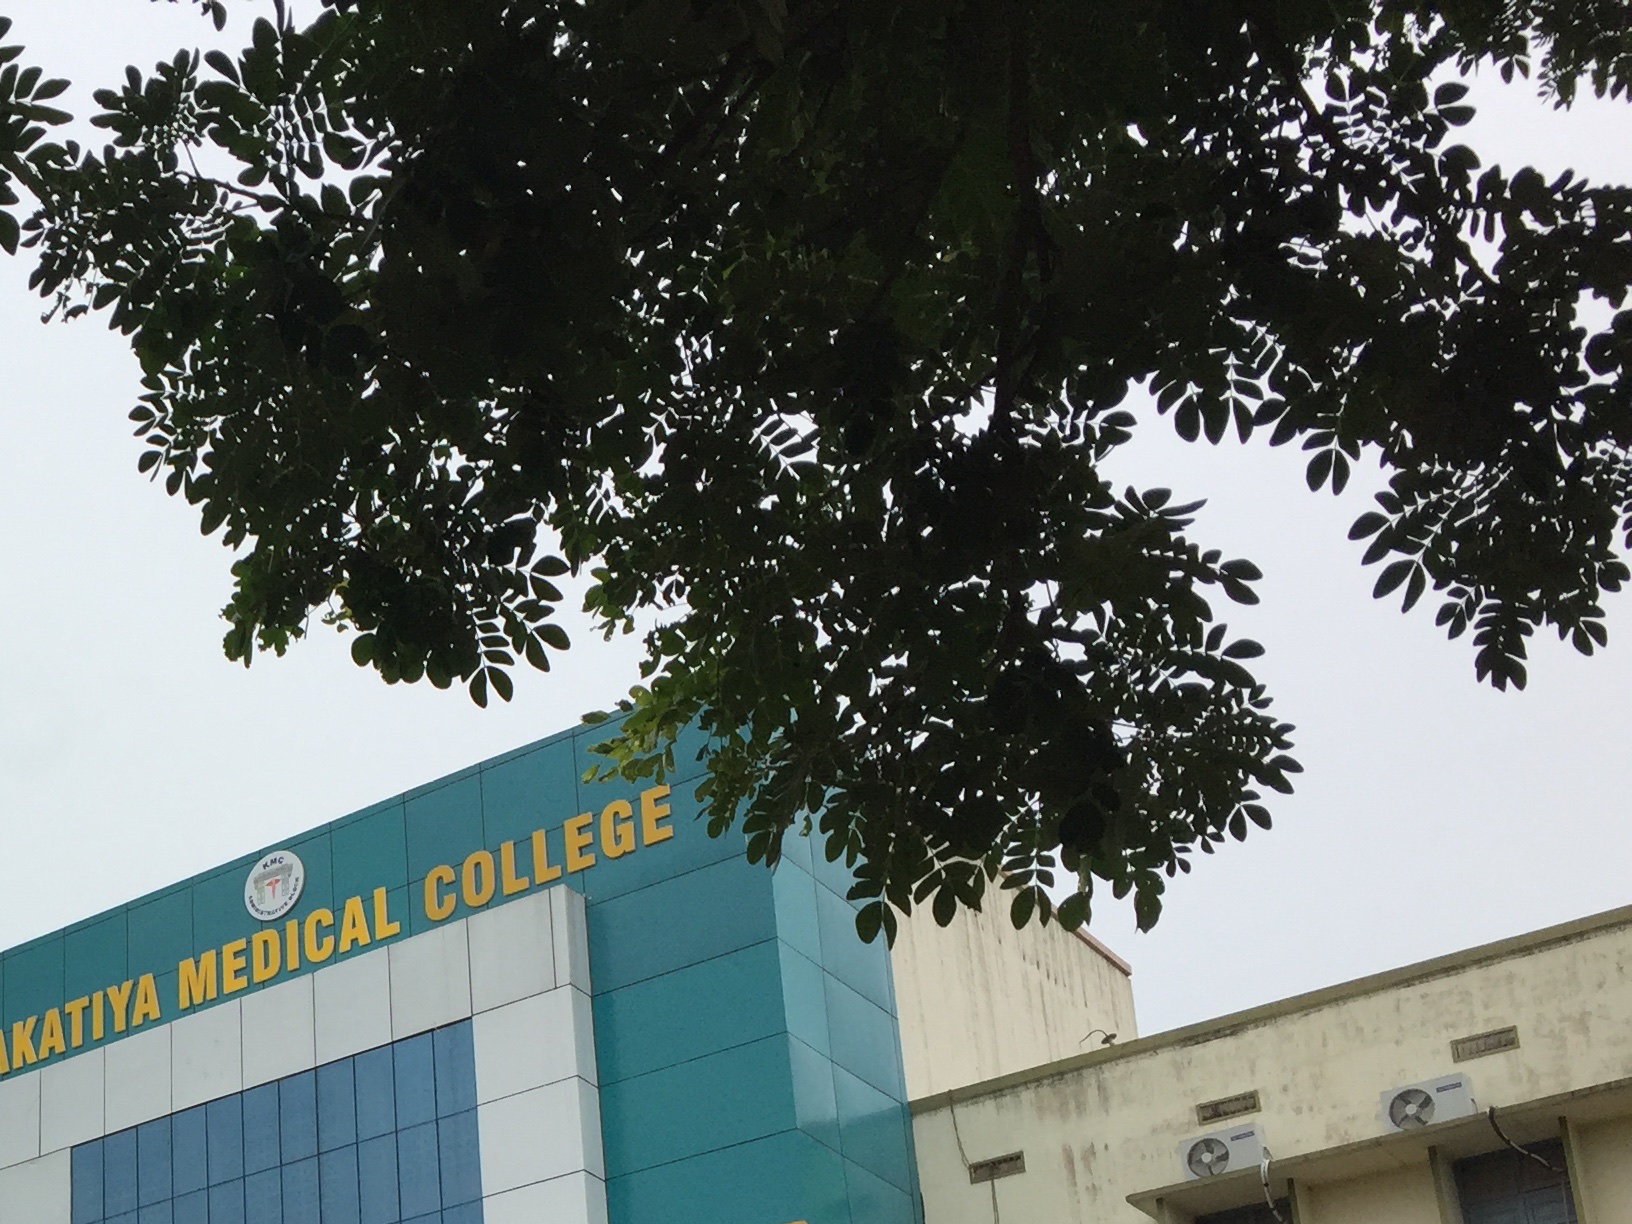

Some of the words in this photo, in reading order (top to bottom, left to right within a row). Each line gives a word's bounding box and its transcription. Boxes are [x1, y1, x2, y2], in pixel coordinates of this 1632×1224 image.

[178, 886, 401, 1009] MEDICAL
[425, 785, 673, 920] COLLEGE
[262, 857, 284, 870] KMC
